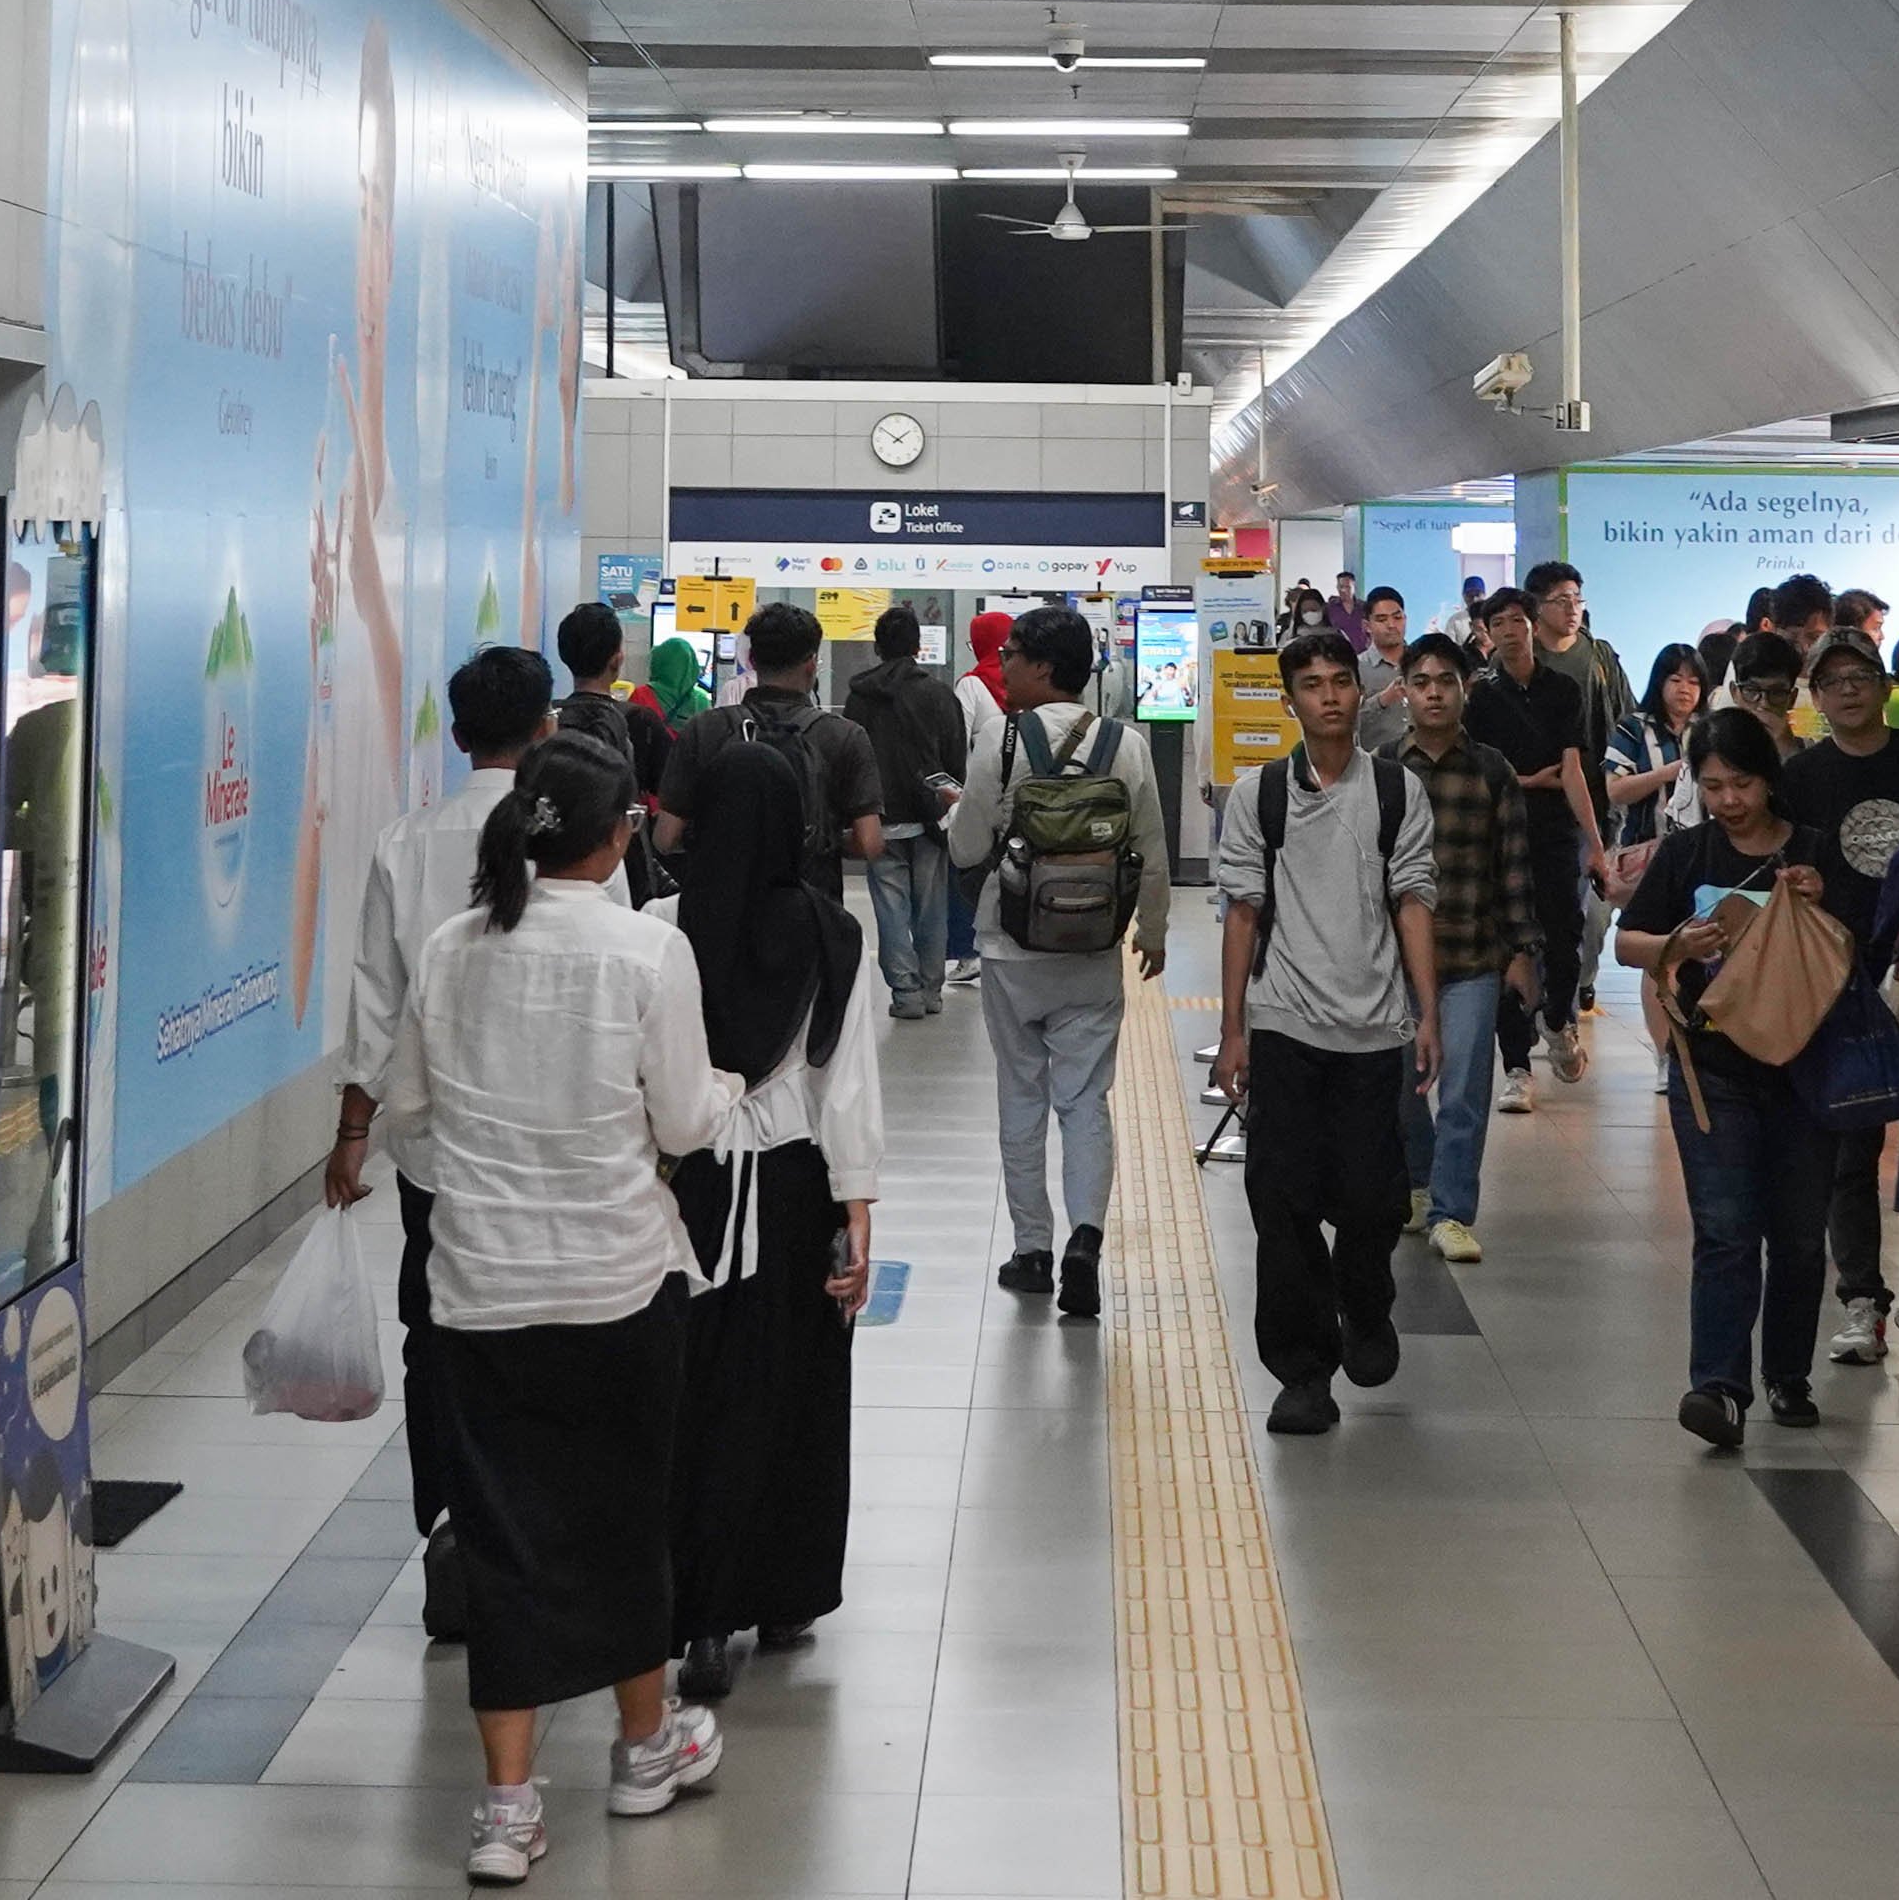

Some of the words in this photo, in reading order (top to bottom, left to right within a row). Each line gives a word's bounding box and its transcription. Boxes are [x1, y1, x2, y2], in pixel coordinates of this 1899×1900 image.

[222, 82, 264, 198] bikin
[182, 230, 236, 348] bebas
[904, 502, 940, 517] Loket
[1689, 490, 1747, 512] “Ada
[1757, 490, 1868, 517] segelnya,
[905, 521, 934, 533] Ticket
[935, 521, 964, 534] Office
[1415, 518, 1427, 530] di
[1604, 520, 1664, 544] bikin
[1674, 520, 1739, 549] yakin
[1748, 525, 1814, 544] aman
[1824, 521, 1871, 544] dari
[600, 565, 633, 577] SATU
[1051, 562, 1089, 573] gopay
[1114, 562, 1137, 574] Yup
[1756, 555, 1806, 571] Prinka
[222, 711, 236, 770] Le
[204, 762, 249, 828] Minerale
